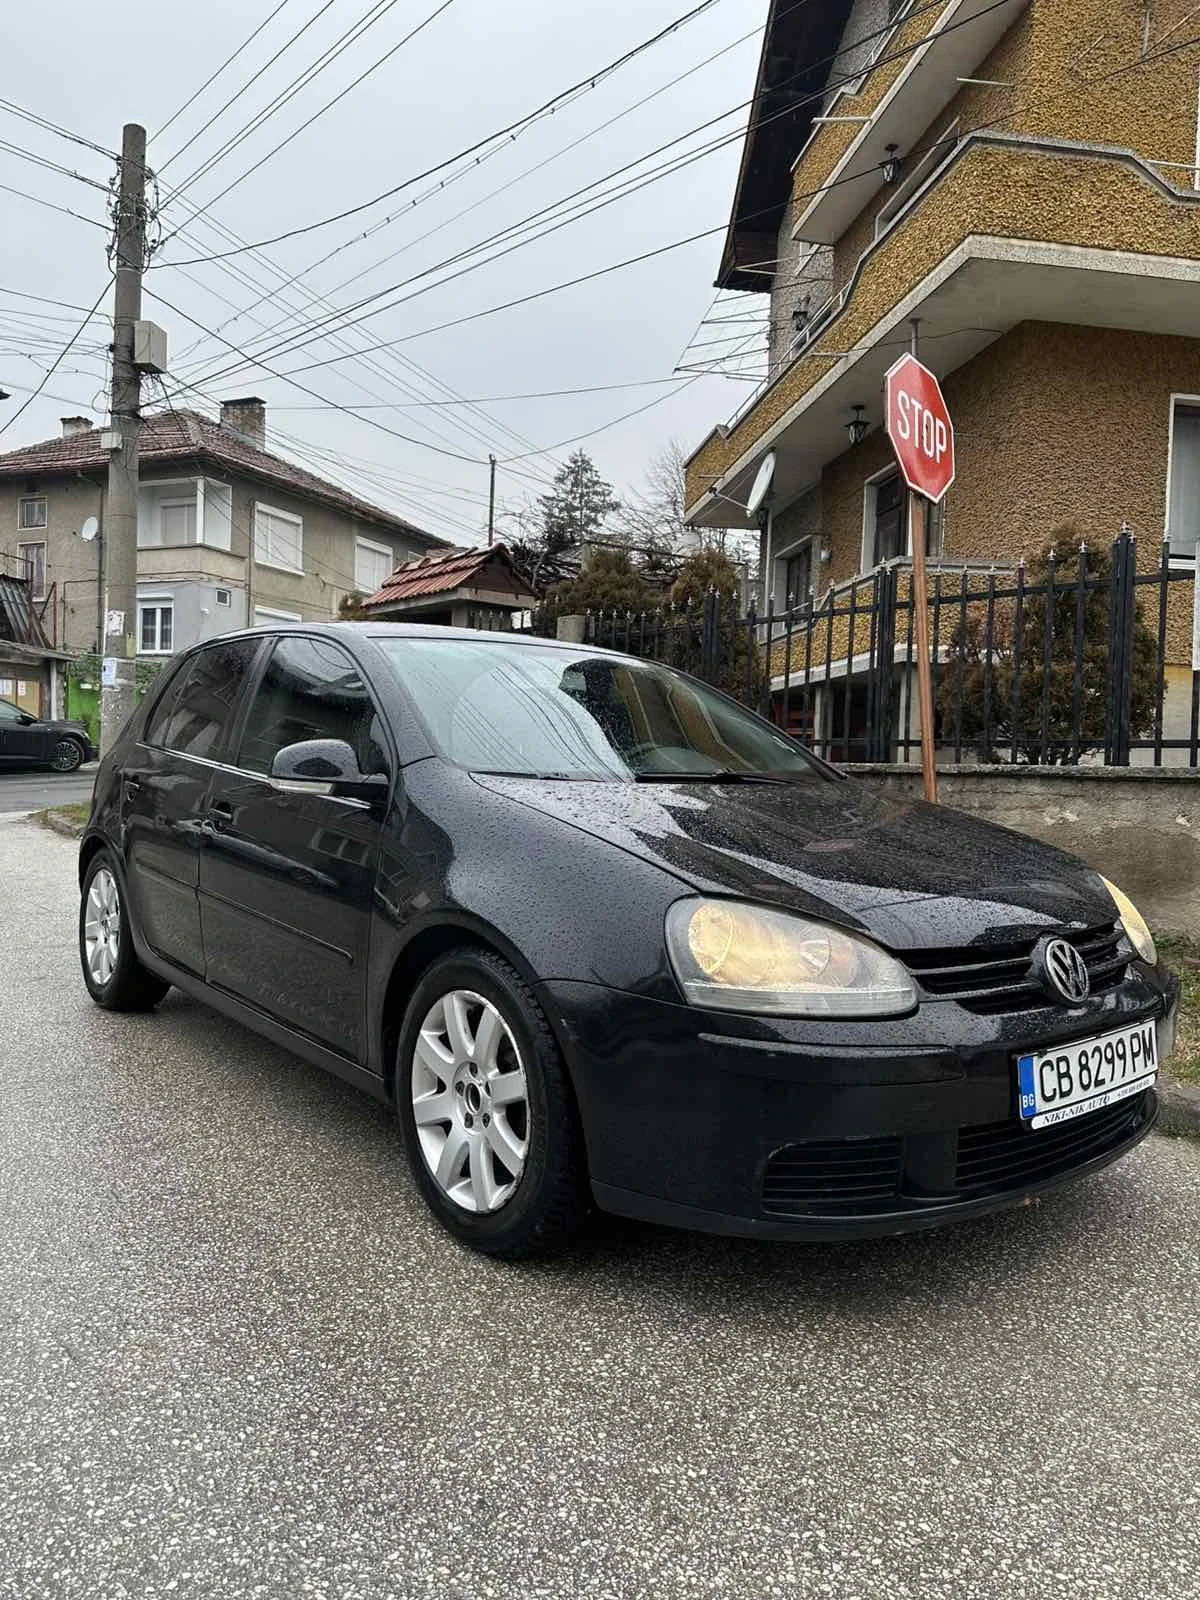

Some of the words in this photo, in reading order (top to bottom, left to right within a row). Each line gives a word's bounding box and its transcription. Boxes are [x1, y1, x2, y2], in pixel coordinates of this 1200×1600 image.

[897, 390, 947, 464] STOP
[1046, 940, 1089, 1002] VW
[1040, 1056, 1073, 1102] CB
[1078, 1038, 1126, 1091] 8299
[1130, 1027, 1155, 1073] PM
[1022, 1093, 1035, 1108] BG
[1086, 1095, 1111, 1111] AUTO
